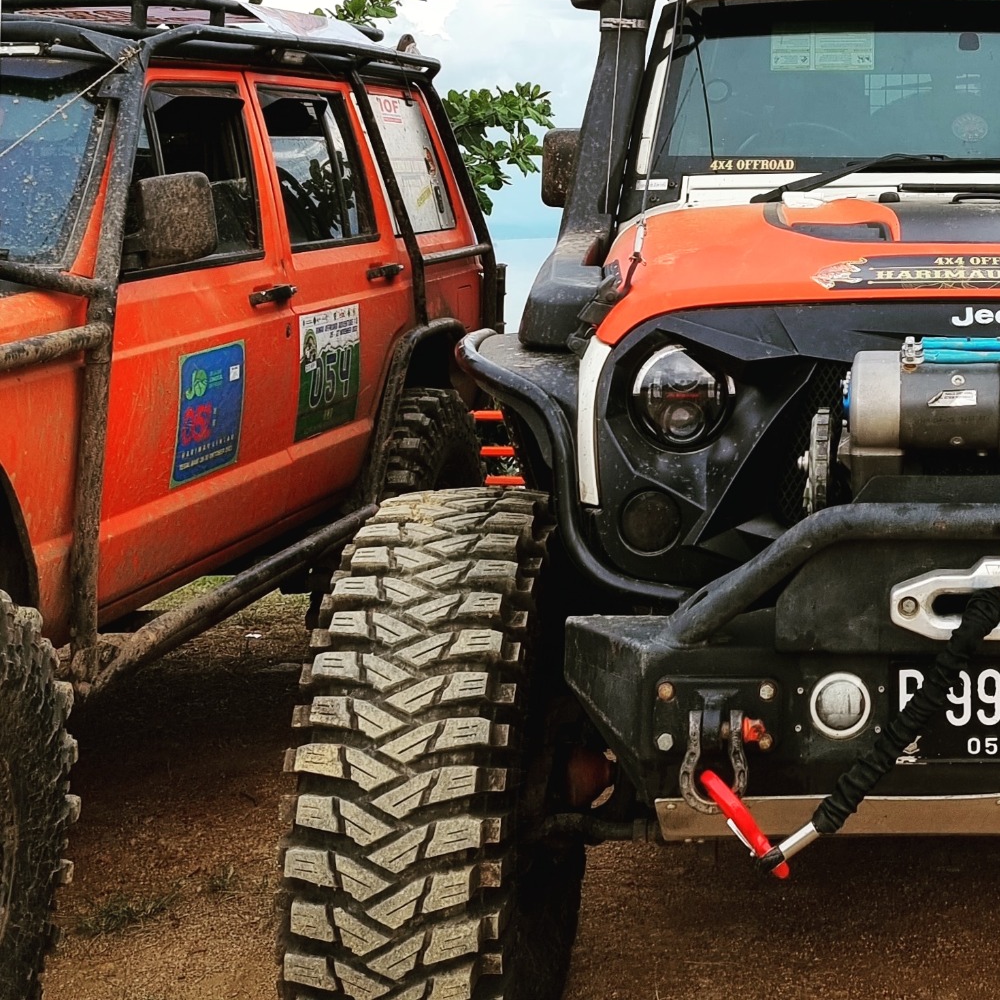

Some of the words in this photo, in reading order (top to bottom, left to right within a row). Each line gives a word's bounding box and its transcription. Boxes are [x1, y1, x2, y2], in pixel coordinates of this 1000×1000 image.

[380, 99, 399, 114] IOF
[736, 159, 795, 171] OFFROAD
[309, 347, 352, 408] 054
